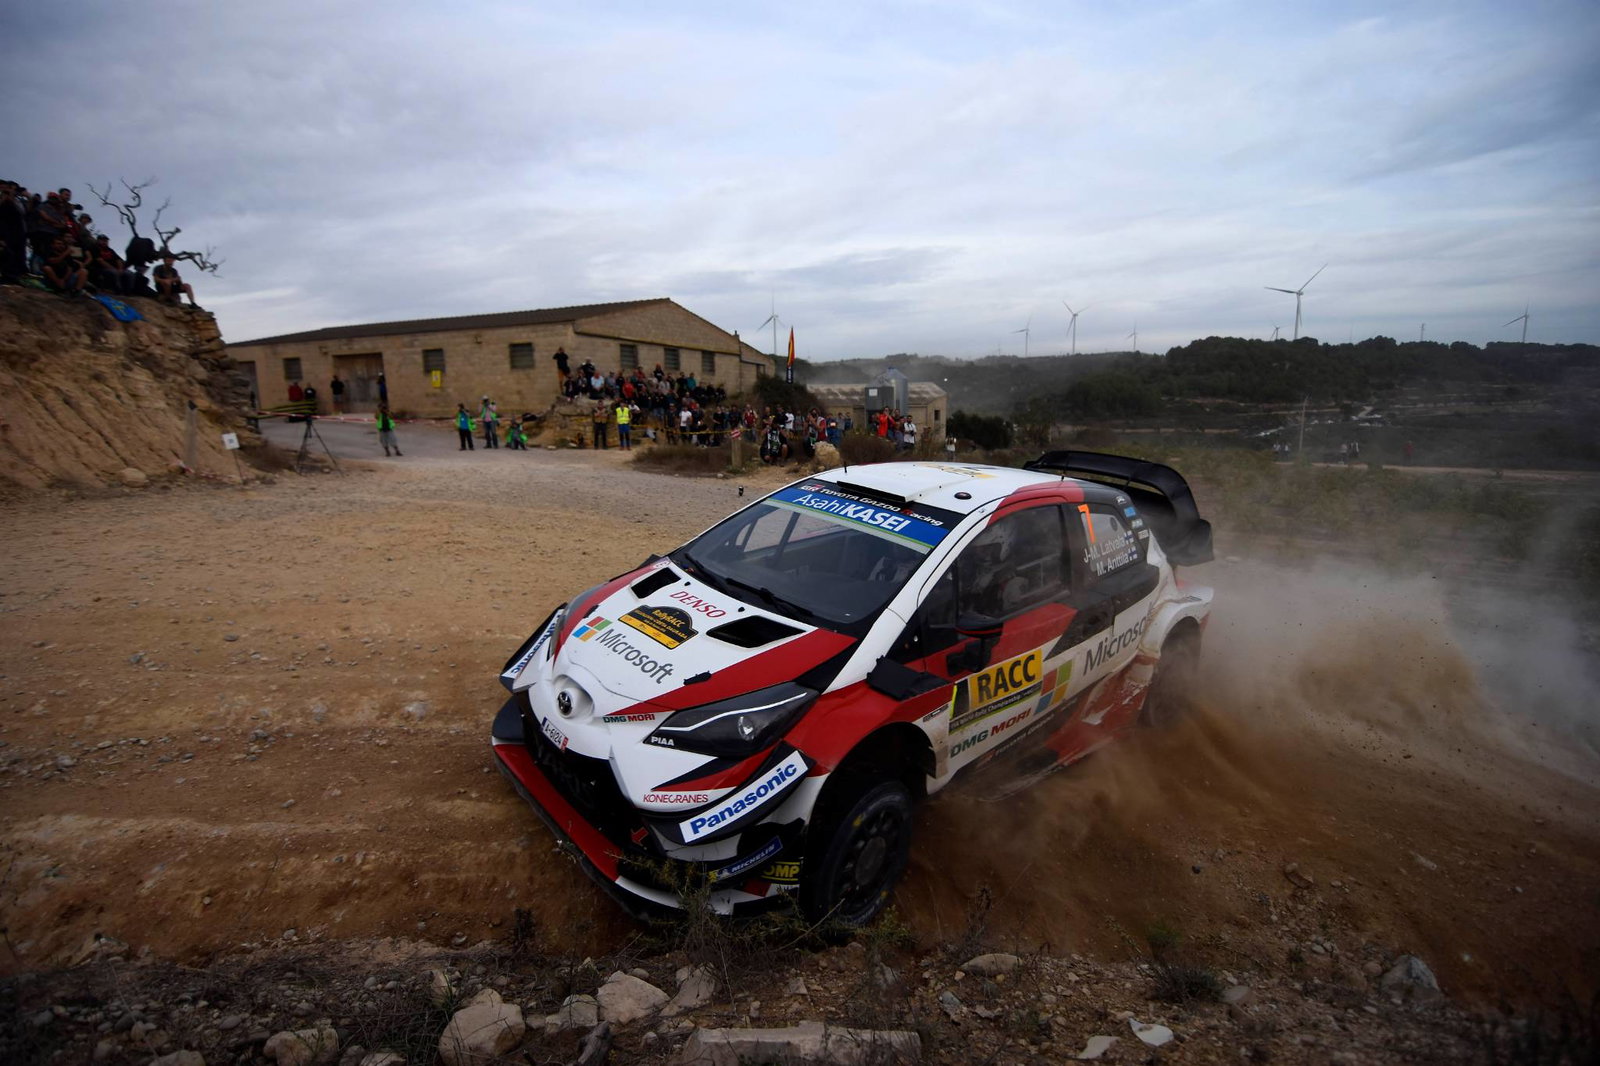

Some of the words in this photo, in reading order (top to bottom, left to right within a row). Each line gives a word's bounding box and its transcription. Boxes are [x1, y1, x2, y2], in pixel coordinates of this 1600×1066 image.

[820, 488, 859, 501] TOYOTA
[859, 497, 901, 512] GAZOO
[901, 509, 944, 527] Racing
[670, 591, 727, 618] DENSO
[596, 628, 675, 684] Microsoft
[976, 654, 1036, 704] RACC
[602, 715, 627, 723] DMG
[627, 713, 655, 722] MORI
[950, 730, 989, 758] DMG
[990, 707, 1031, 737] MORI
[651, 736, 675, 746] PIAA
[643, 794, 709, 804] KONECRANES
[690, 763, 798, 835] Panasonic
[732, 845, 775, 872] MICHELIN
